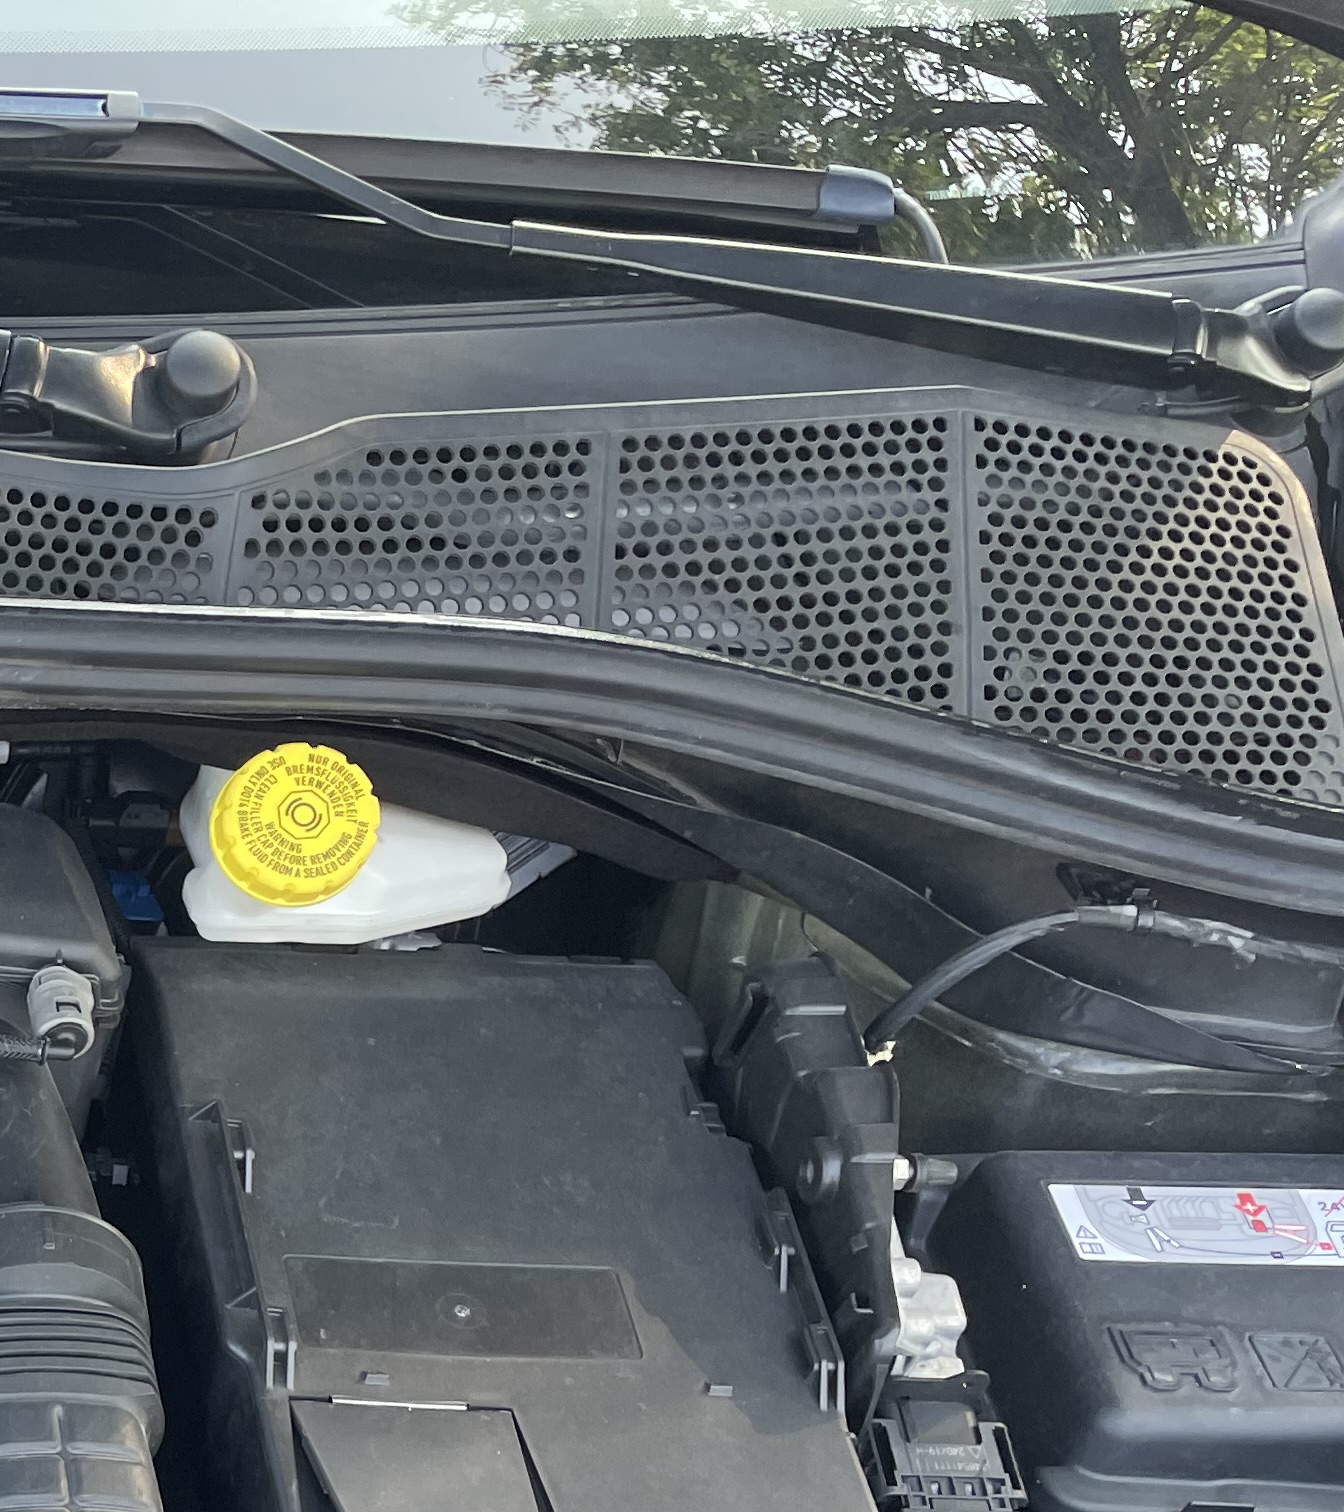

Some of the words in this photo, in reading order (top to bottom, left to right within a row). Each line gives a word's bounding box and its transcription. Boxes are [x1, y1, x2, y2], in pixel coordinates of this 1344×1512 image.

[248, 765, 270, 787] ONLY
[267, 755, 287, 771] USE
[253, 774, 278, 801] CLEAN
[308, 753, 330, 767] NUR
[330, 761, 366, 801] ORIGINAL
[294, 776, 345, 817] VERWENDEN
[237, 810, 254, 840] BRAKE
[249, 801, 264, 834] FILLER
[256, 833, 275, 850] CAP
[264, 821, 303, 854] WARNING
[310, 831, 353, 866] REMOVING
[336, 820, 370, 867] CONTAINER
[245, 839, 269, 864] FLUID
[270, 846, 308, 867] BEFORE
[266, 858, 294, 877] FROM
[303, 861, 339, 879] SEALED
